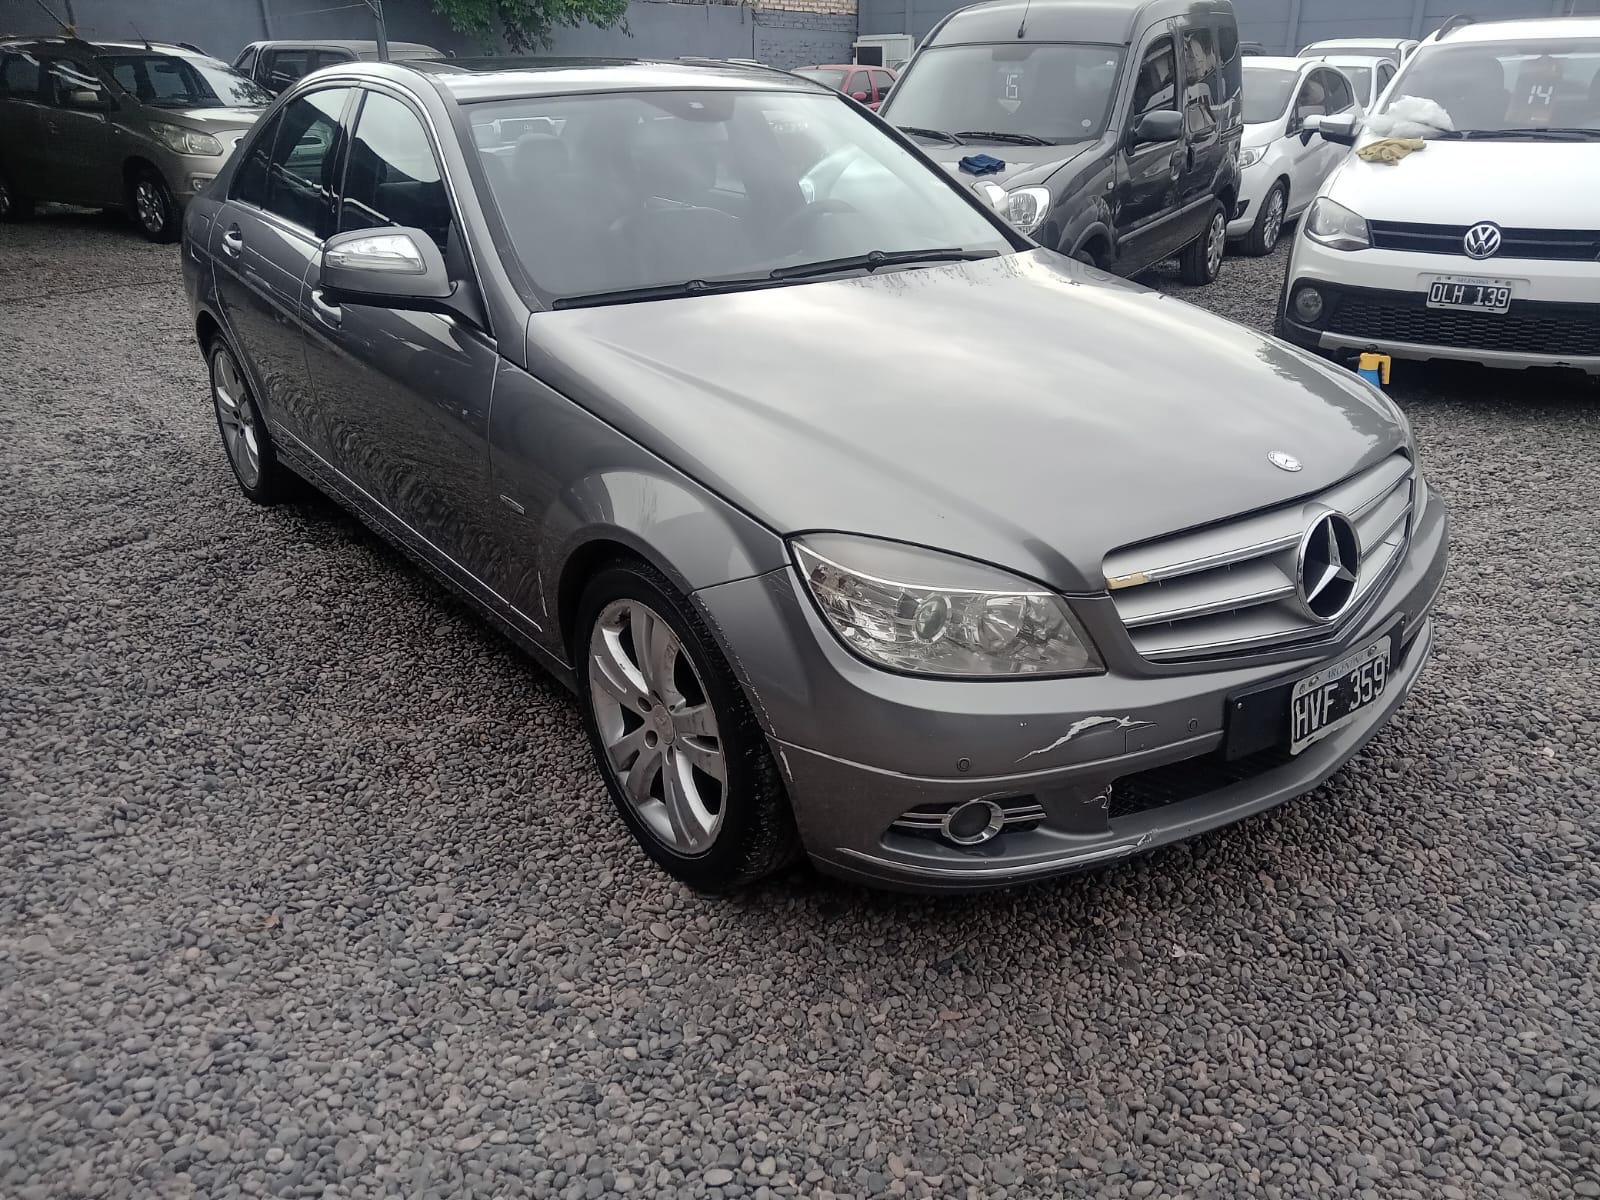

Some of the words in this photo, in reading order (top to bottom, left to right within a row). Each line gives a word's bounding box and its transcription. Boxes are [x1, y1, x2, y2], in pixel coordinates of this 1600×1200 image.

[1527, 85, 1553, 105] 14
[1430, 283, 1465, 304] OLH
[1473, 286, 1509, 307] 139
[1295, 683, 1339, 740] HVF
[1348, 656, 1386, 712] 359
